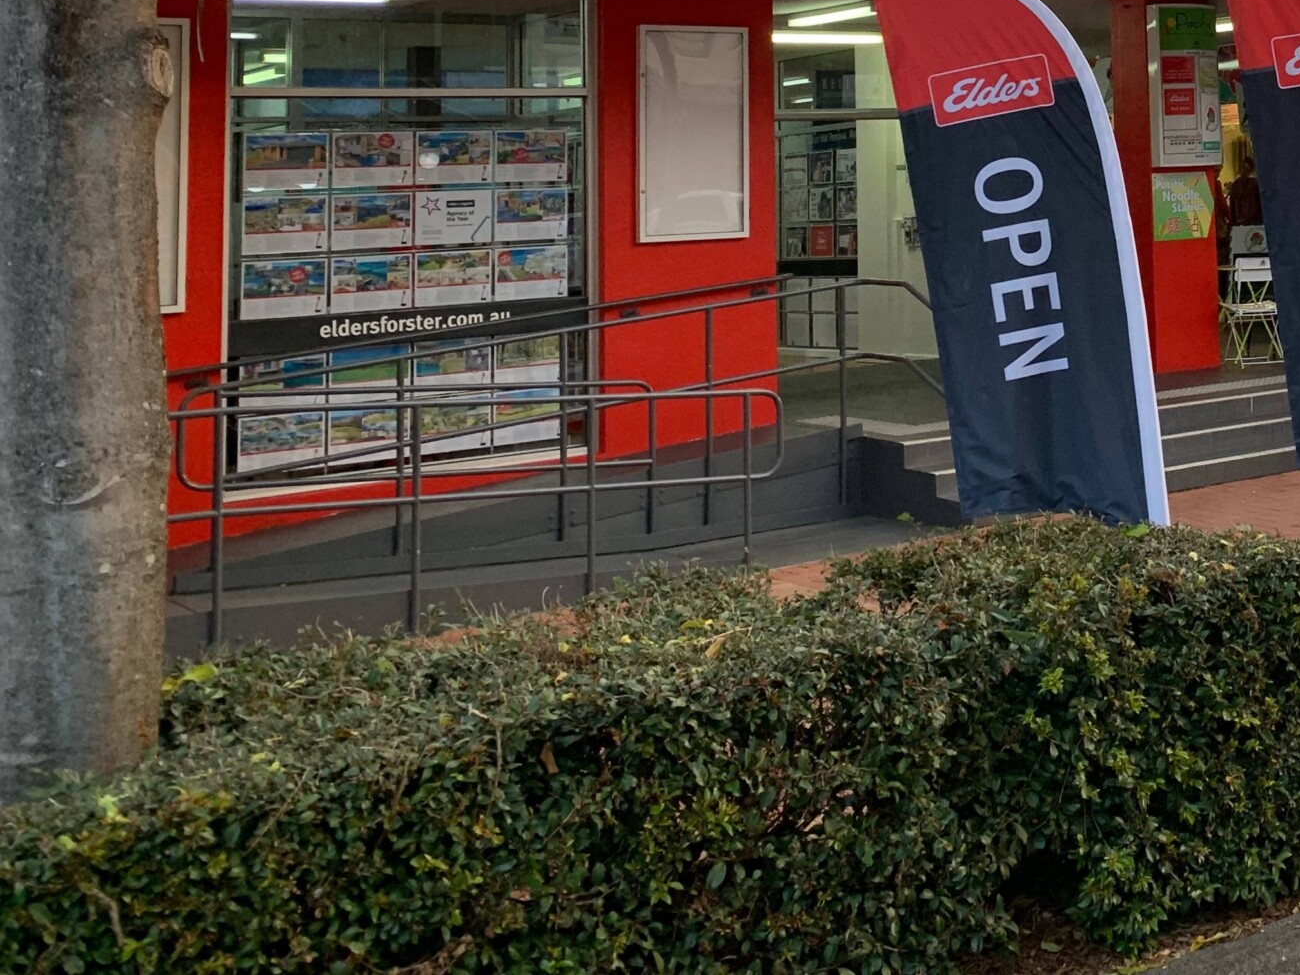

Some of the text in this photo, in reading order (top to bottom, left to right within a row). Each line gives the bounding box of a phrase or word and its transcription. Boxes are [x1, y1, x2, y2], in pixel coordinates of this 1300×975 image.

[943, 73, 1042, 111] Elders
[1162, 189, 1200, 202] Noodle
[974, 156, 1069, 382] OPEN
